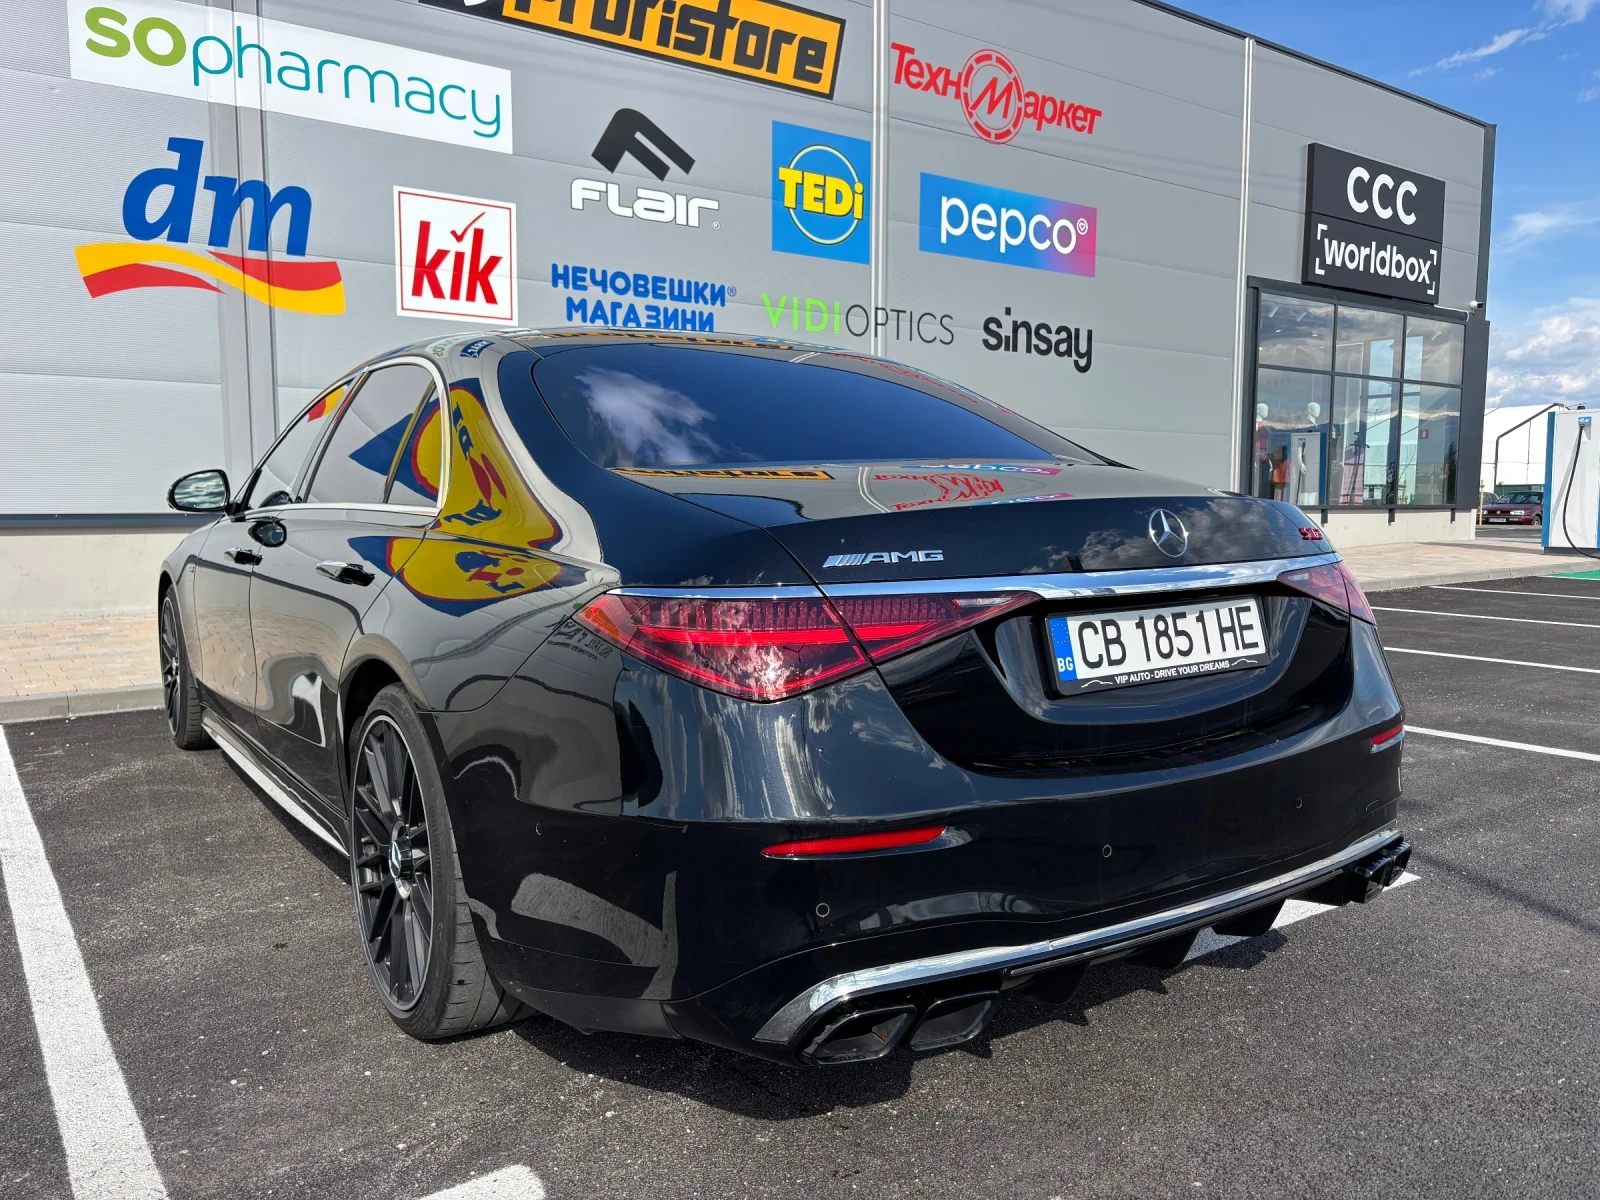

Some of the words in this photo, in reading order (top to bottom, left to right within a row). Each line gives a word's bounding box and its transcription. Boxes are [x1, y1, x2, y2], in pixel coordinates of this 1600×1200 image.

[122, 137, 312, 257] dm
[778, 166, 864, 220] TEDi
[1347, 167, 1418, 225] CCC
[940, 196, 1077, 254] pepco
[1324, 238, 1431, 284] worldbox
[566, 297, 714, 332] МАГАЗИНИ
[982, 307, 1093, 373] sinsay
[862, 550, 944, 565] AMG
[1057, 657, 1074, 672] BG
[1077, 619, 1127, 669] CB
[1114, 675, 1129, 685] VIP
[1129, 673, 1151, 683] AUTO
[1154, 669, 1178, 679] DRIVE
[1178, 665, 1199, 676] YOUR
[1199, 660, 1230, 673] DREAMS
